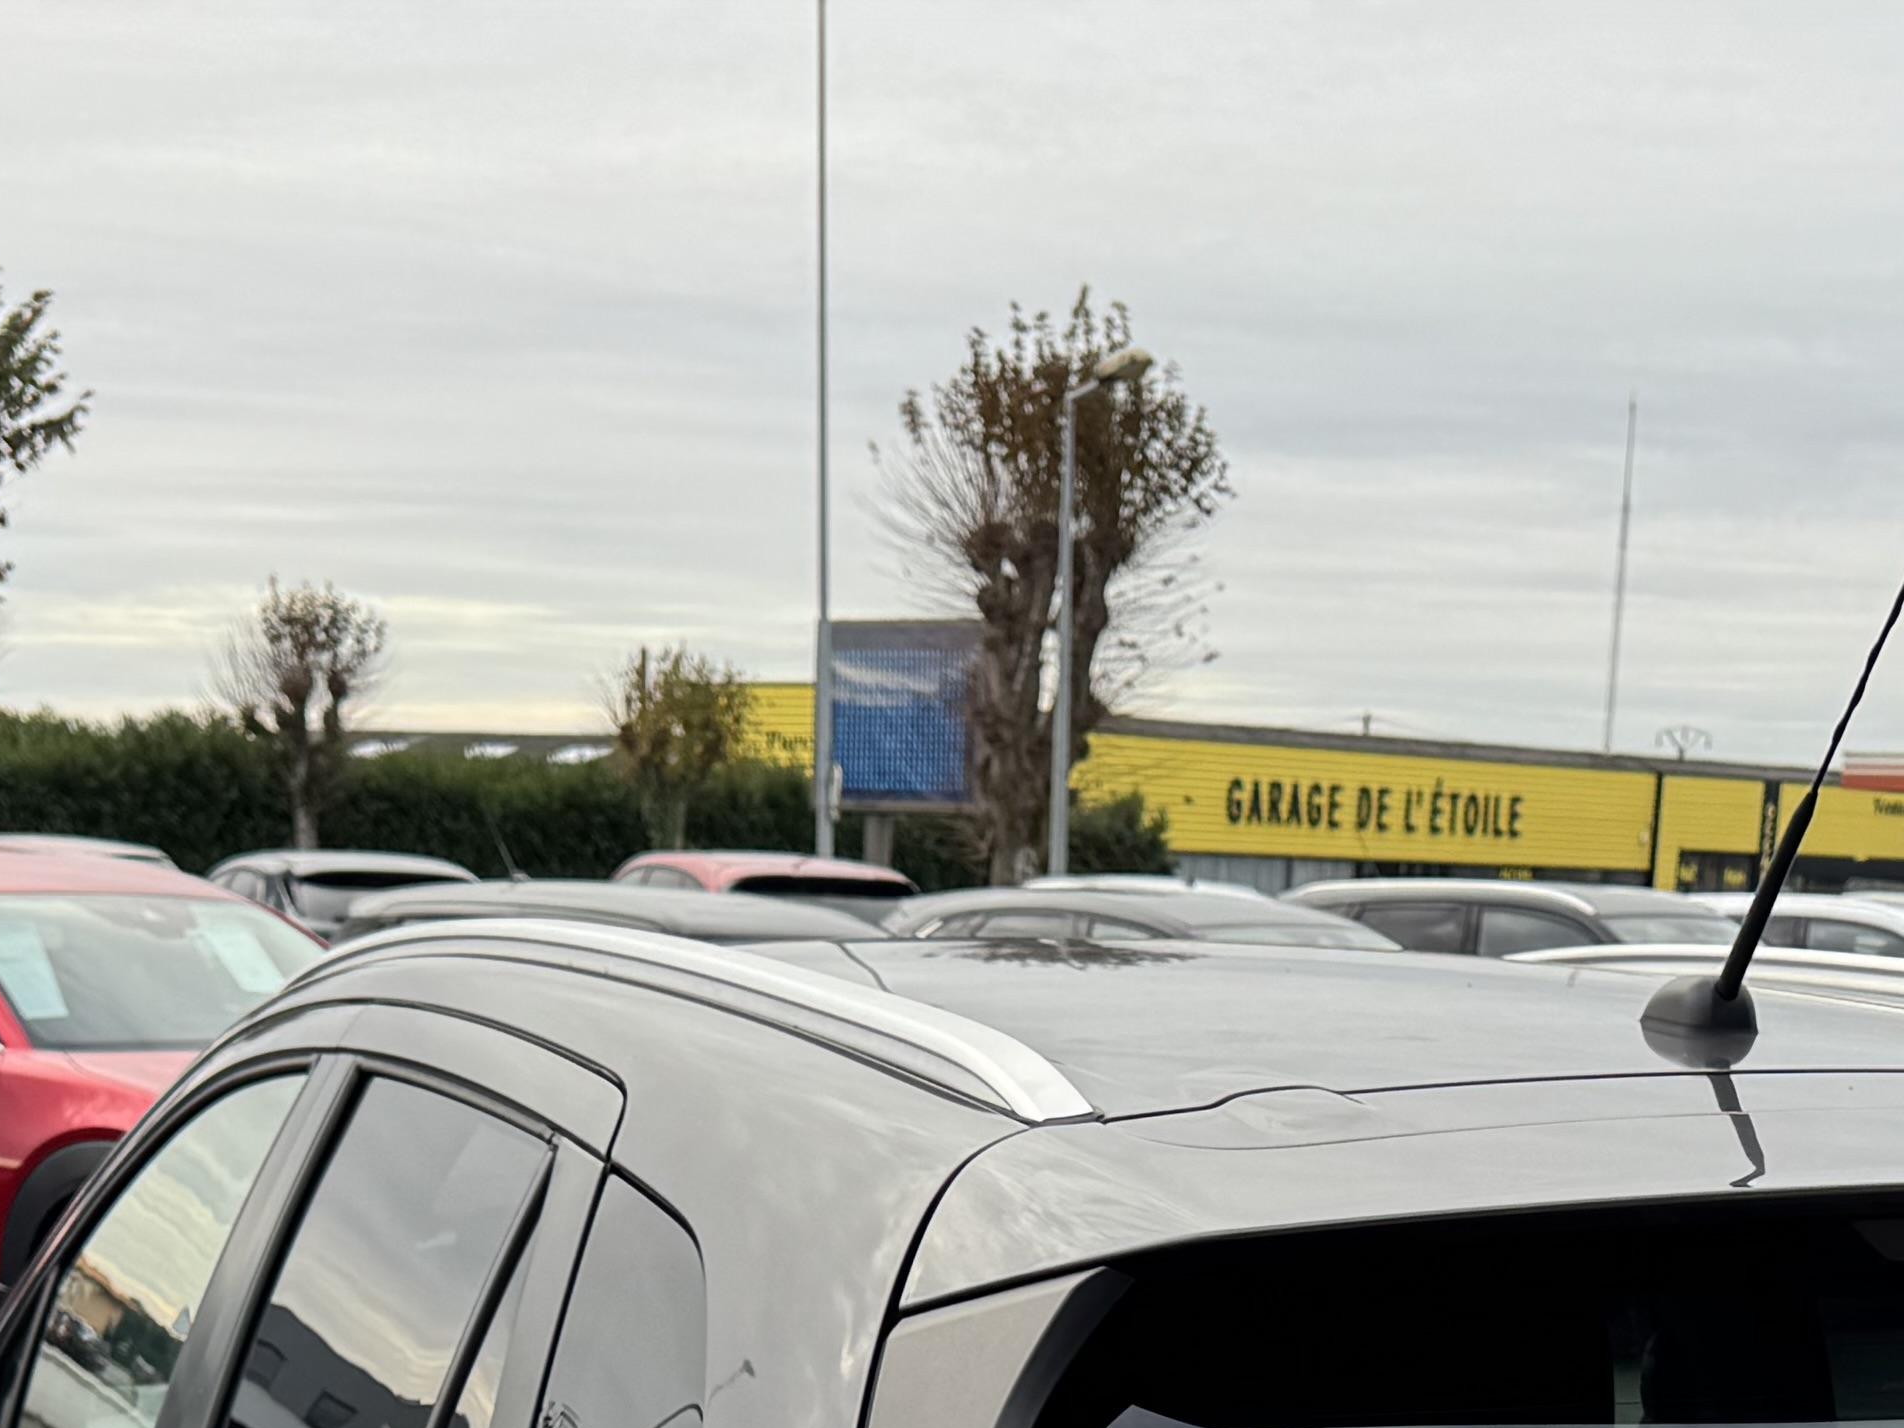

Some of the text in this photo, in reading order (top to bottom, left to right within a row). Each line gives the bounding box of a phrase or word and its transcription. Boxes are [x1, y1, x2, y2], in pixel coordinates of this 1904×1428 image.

[1225, 777, 1525, 838] GARAGE DE L'ÉTOILE
